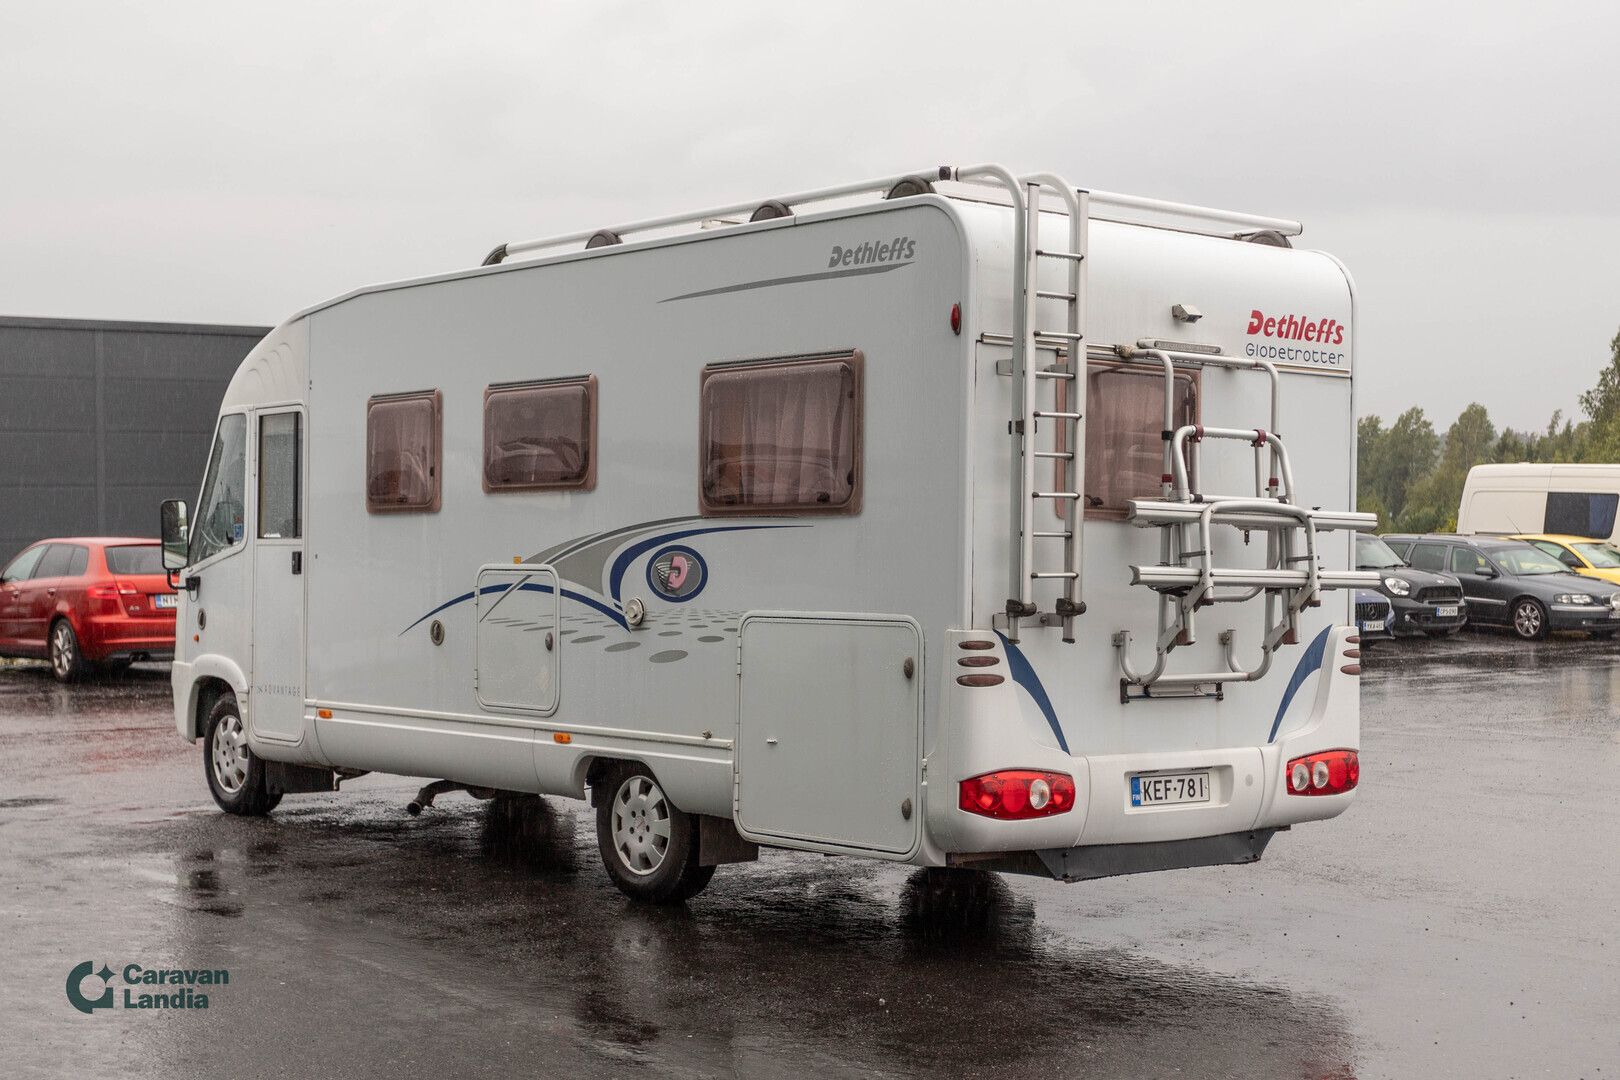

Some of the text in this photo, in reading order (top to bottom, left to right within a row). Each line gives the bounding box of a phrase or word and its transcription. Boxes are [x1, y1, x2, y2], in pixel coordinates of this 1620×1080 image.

[828, 237, 916, 268] Dethleffs
[1247, 310, 1344, 345] Dethleffs
[1246, 343, 1344, 364] Globetrotter
[1143, 777, 1203, 801] KEF-781
